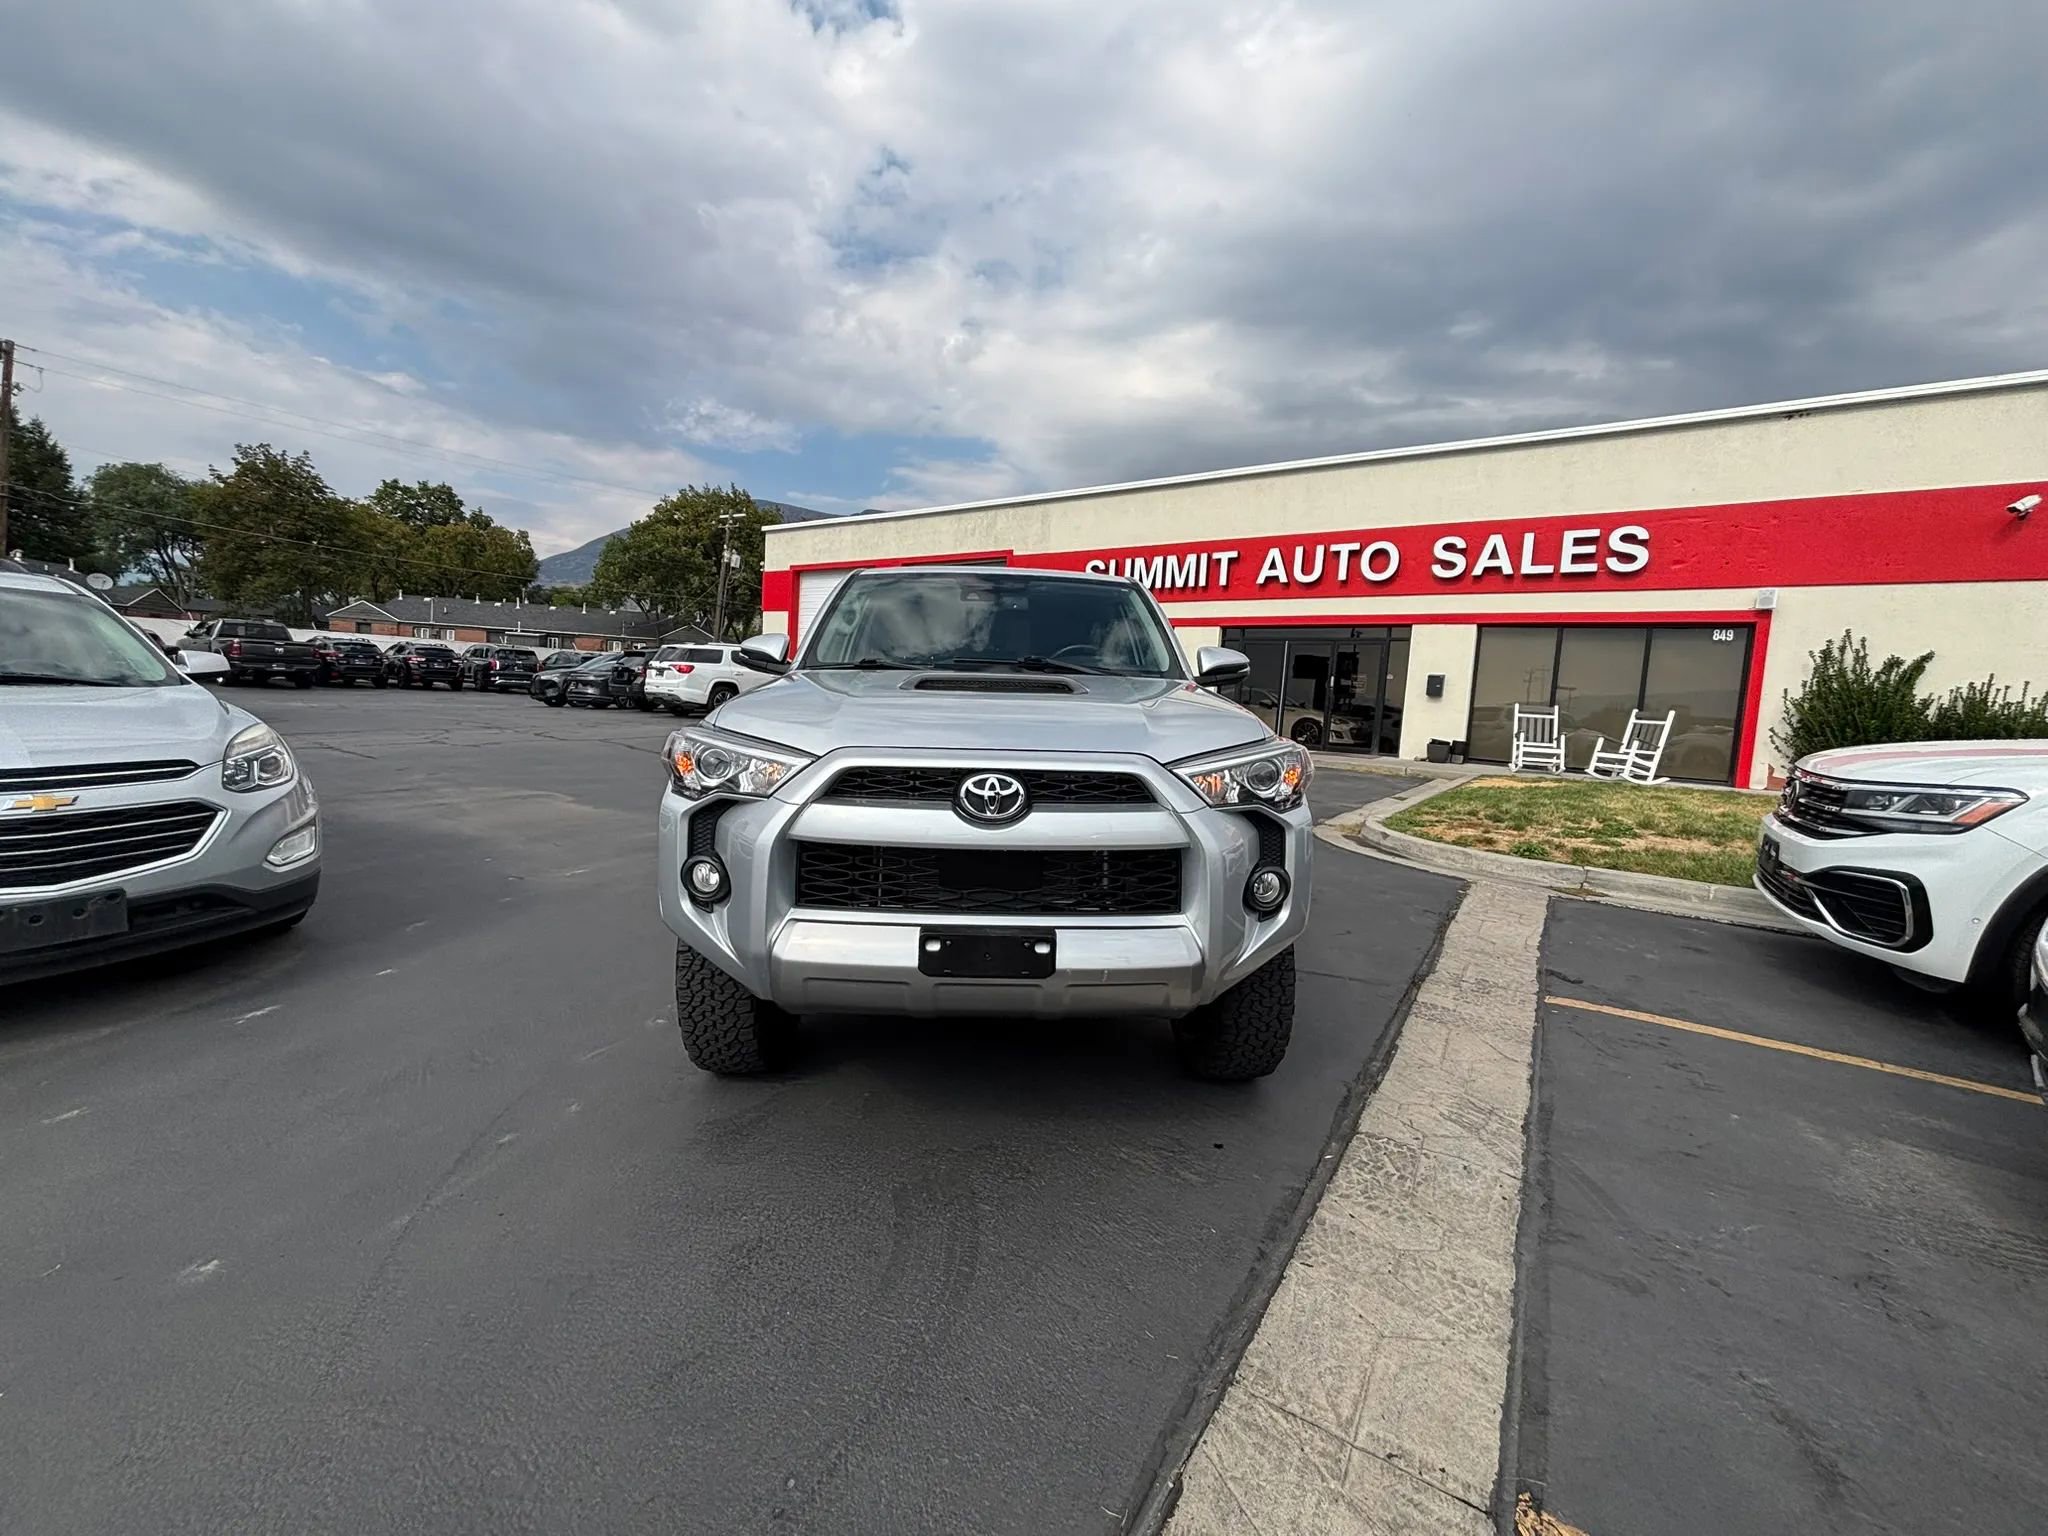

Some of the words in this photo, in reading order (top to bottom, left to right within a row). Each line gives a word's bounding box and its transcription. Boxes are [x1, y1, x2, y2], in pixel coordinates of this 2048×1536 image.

[1256, 540, 1400, 584] AUTO
[1431, 525, 1650, 578] SALES
[1712, 629, 1734, 641] 849
